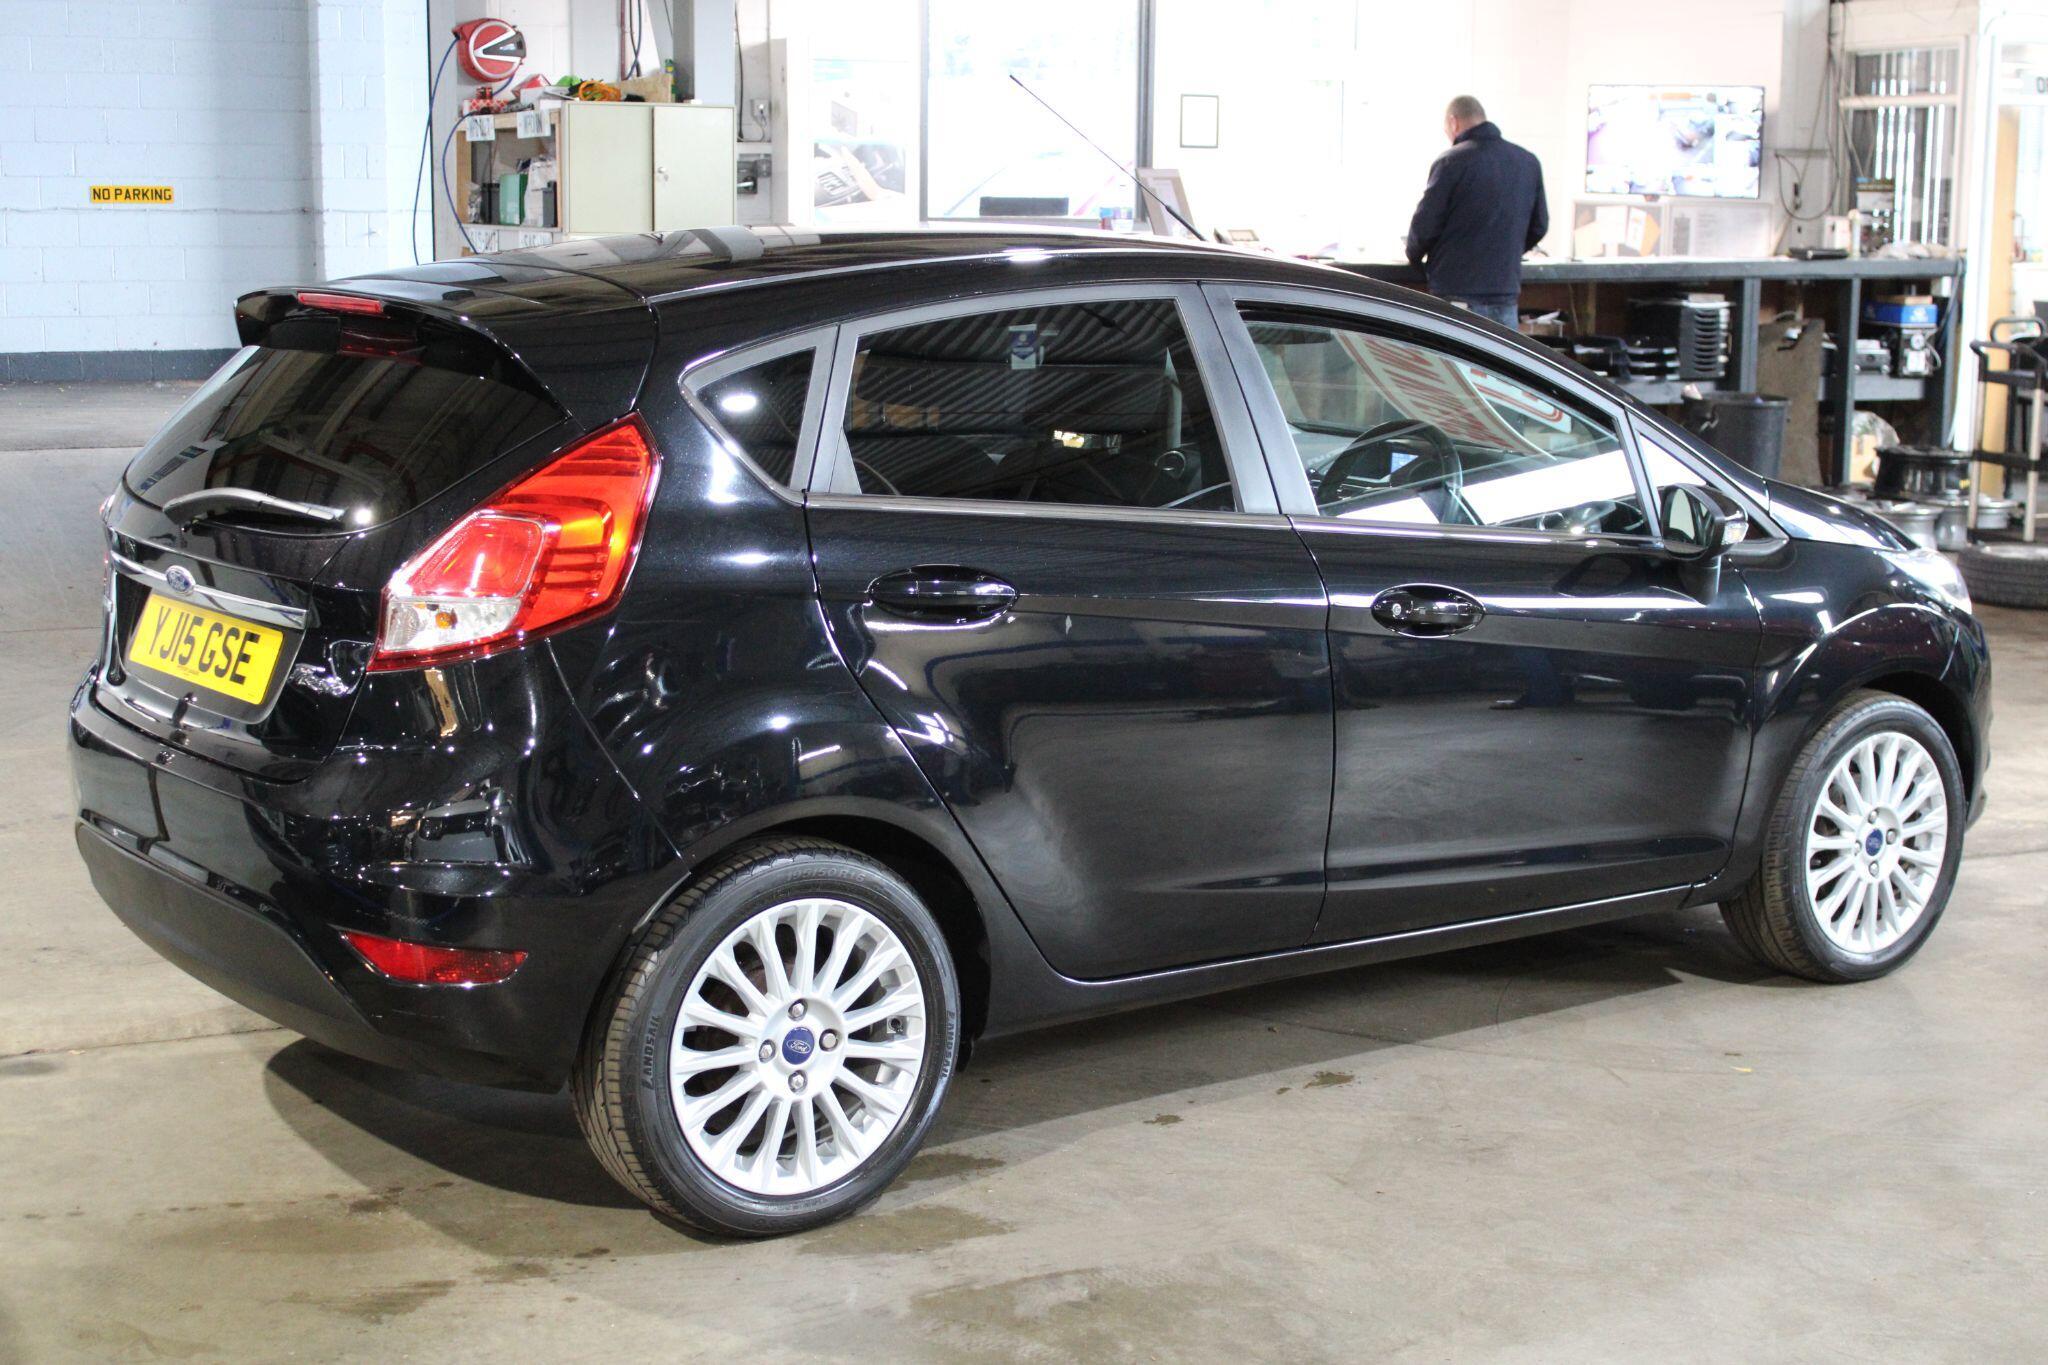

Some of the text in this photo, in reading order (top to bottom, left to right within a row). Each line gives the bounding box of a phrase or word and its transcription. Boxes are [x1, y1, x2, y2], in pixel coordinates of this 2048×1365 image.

[92, 188, 172, 201] NO PARKING
[149, 606, 261, 685] YJ15 GSE
